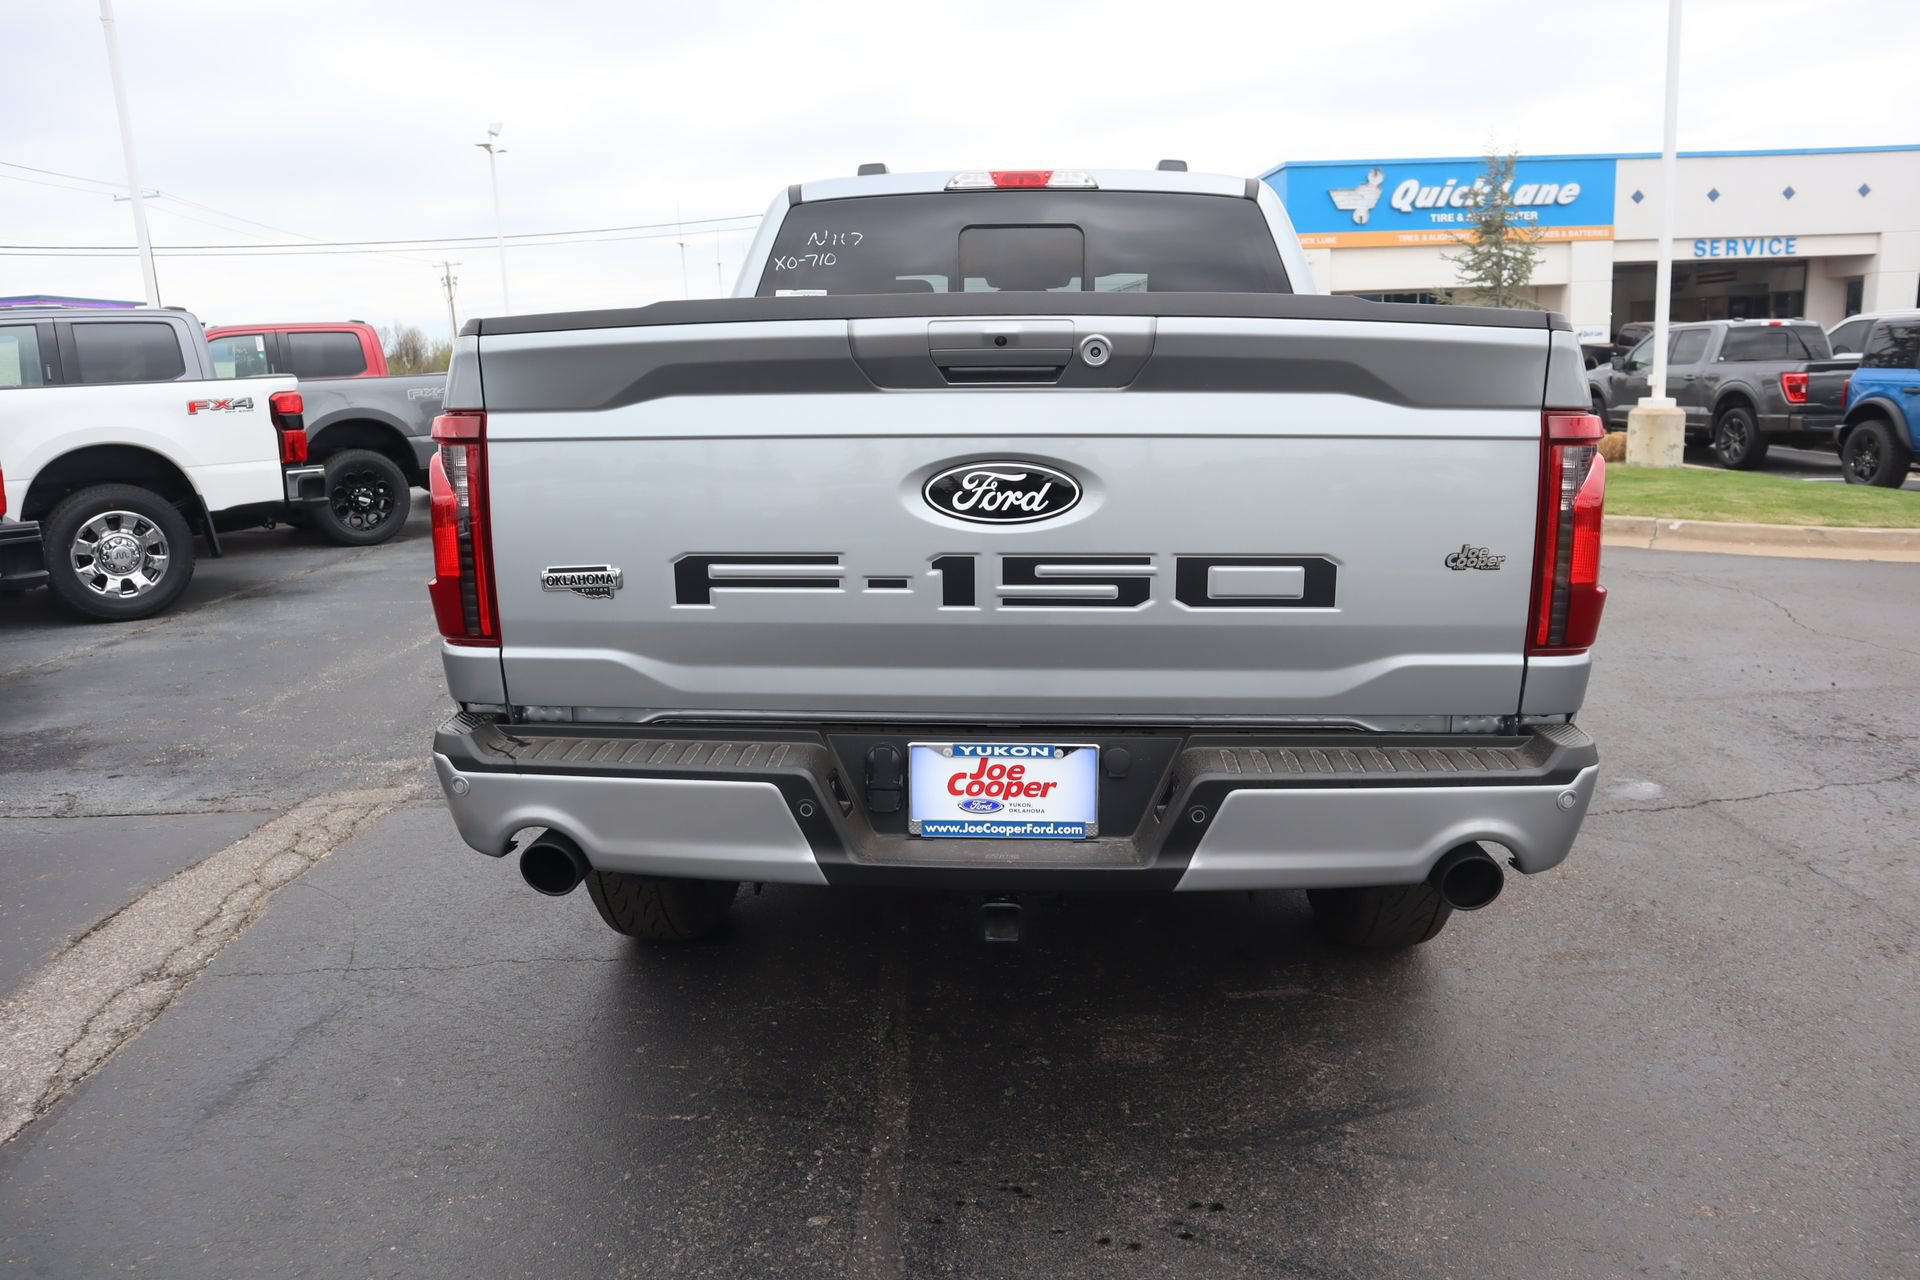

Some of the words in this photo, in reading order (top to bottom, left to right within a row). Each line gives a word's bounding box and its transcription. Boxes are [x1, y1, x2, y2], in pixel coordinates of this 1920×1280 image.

[1391, 176, 1490, 212] Quick
[1430, 212, 1455, 223] TIRE
[1456, 213, 1464, 222] &
[1694, 236, 1798, 258] SERVICE
[187, 396, 255, 415] FX4
[951, 470, 1049, 513] Ford
[1444, 552, 1506, 568] Cooper
[1459, 543, 1490, 558] Joe
[546, 573, 615, 587] OKLAHOMA
[671, 553, 1339, 610] F-150
[958, 745, 1050, 757] YUKON
[969, 757, 1026, 781] Joe
[946, 772, 1058, 801] Cooper
[925, 822, 1083, 837] www.JoeCooperFord.com
